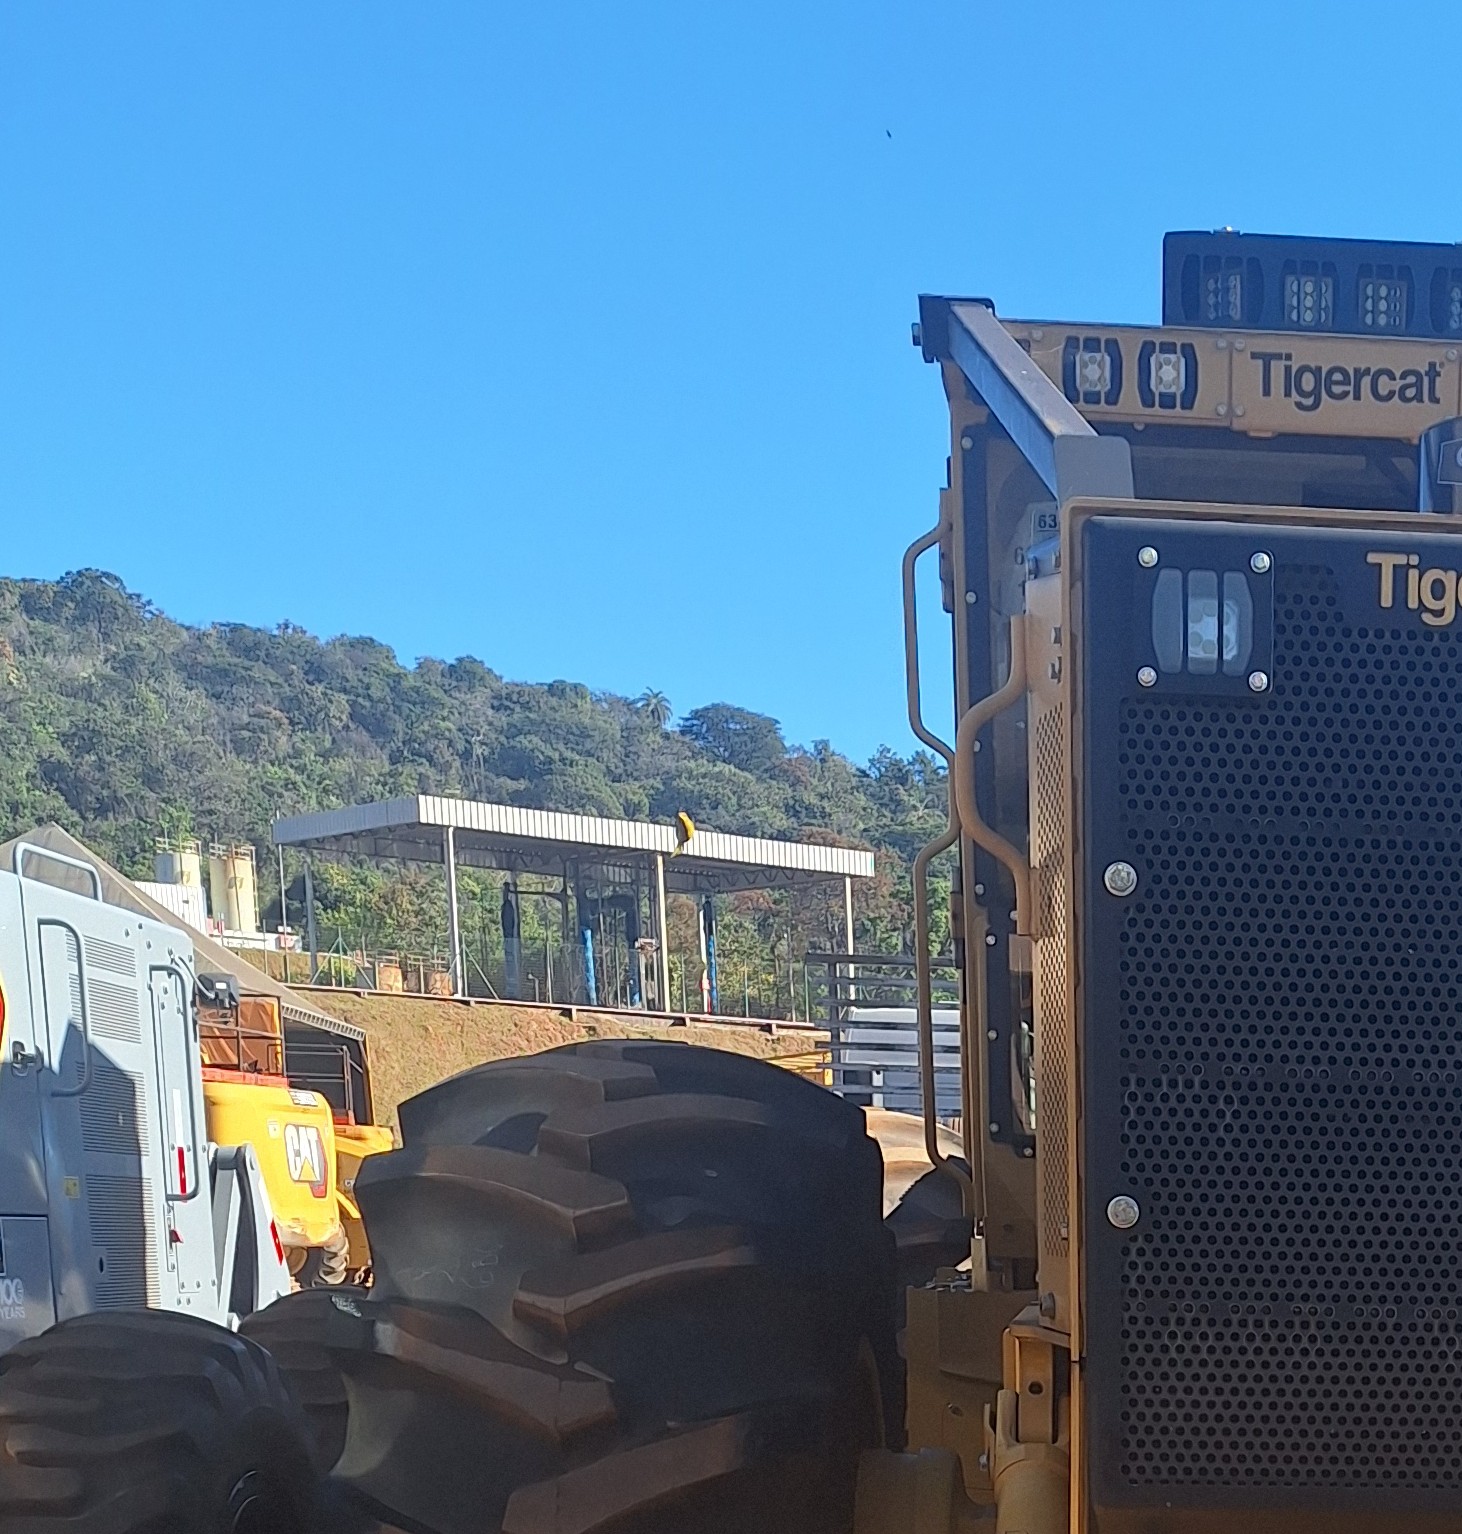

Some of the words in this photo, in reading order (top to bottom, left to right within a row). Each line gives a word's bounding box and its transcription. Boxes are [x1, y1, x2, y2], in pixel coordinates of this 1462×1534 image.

[1250, 351, 1441, 412] Tigercat
[1038, 514, 1058, 529] 63
[284, 1124, 321, 1182] CAT
